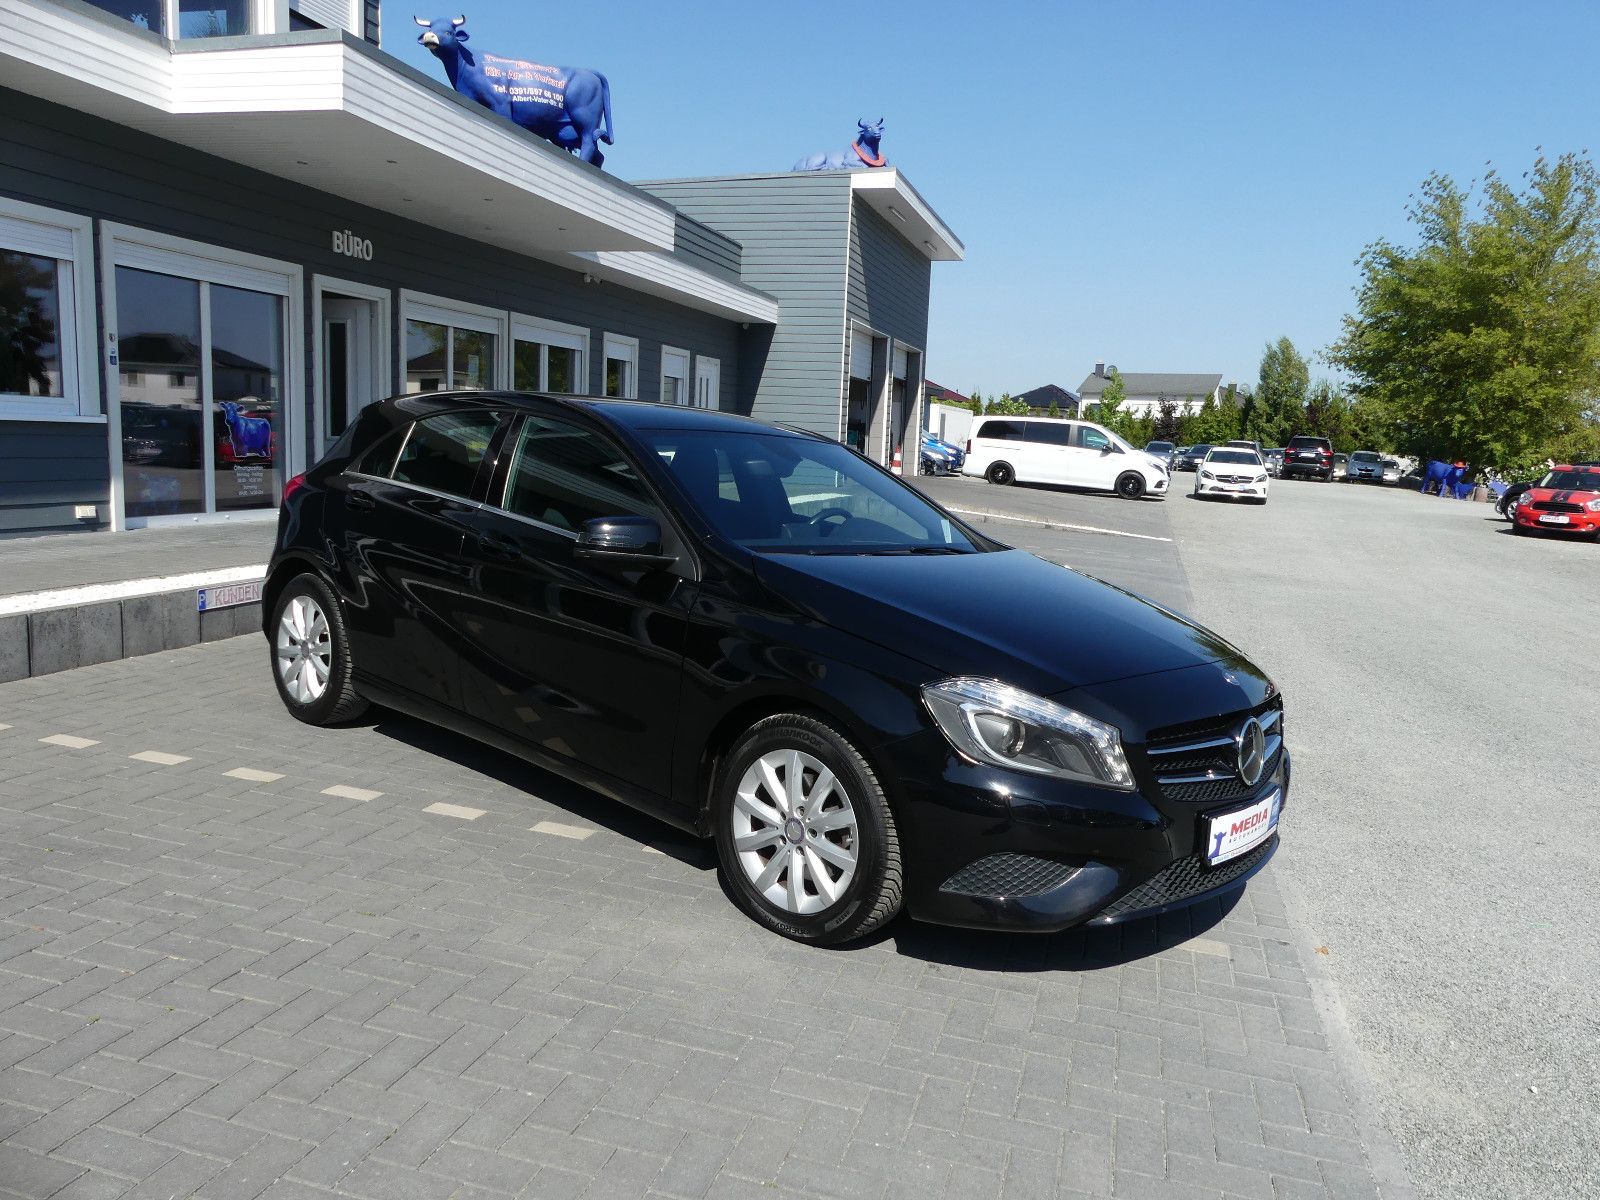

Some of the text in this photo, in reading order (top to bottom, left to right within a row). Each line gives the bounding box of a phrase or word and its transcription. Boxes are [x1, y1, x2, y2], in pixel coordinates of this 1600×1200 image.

[493, 84, 508, 94] Tel.
[332, 229, 373, 261] BÜRO
[214, 583, 260, 607] KUNDEN
[1229, 807, 1269, 837] MEDIA
